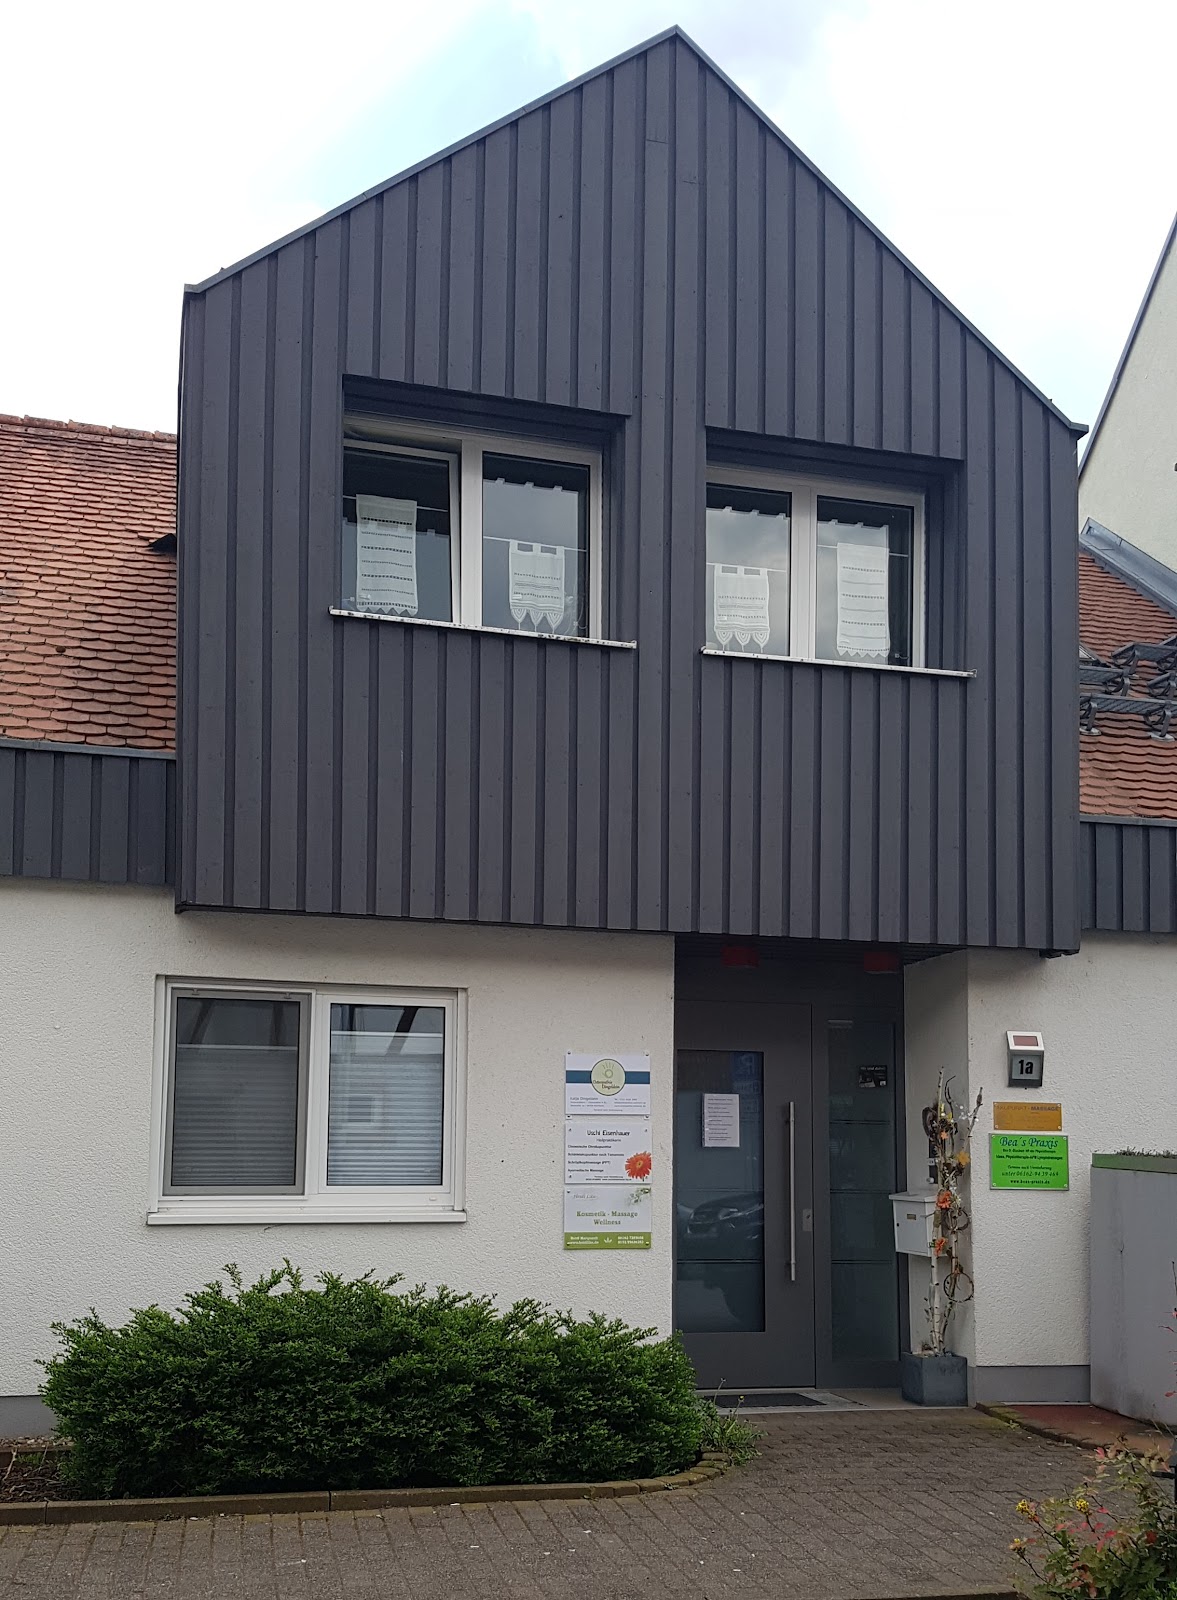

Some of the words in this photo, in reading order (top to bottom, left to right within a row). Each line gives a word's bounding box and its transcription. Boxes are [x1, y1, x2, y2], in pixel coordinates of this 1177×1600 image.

[1018, 1059, 1034, 1075] 1a
[1028, 1137, 1059, 1149] Praxis
[611, 1210, 638, 1218] Massage
